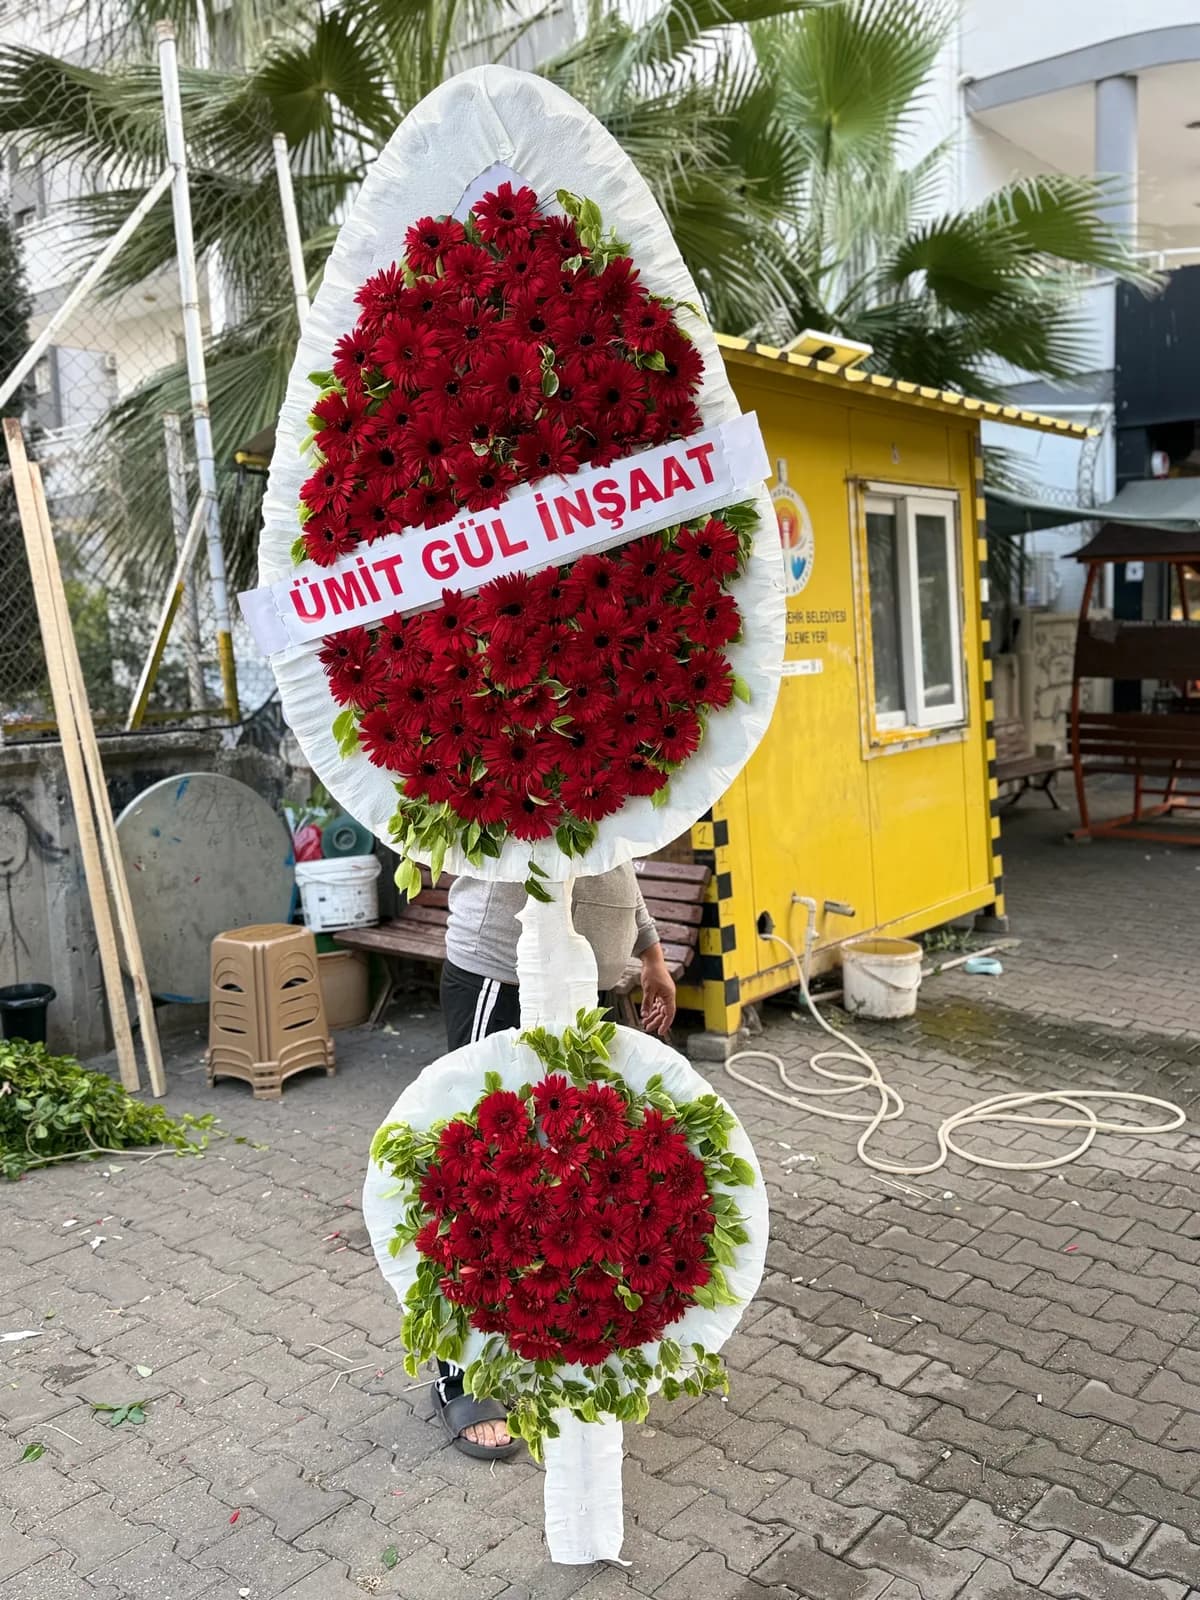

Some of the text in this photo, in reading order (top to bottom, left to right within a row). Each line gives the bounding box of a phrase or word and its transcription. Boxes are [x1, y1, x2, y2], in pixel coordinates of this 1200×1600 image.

[290, 442, 715, 624] ÜMİT GÜL İNŞAAT
[786, 609, 803, 624] EHİR
